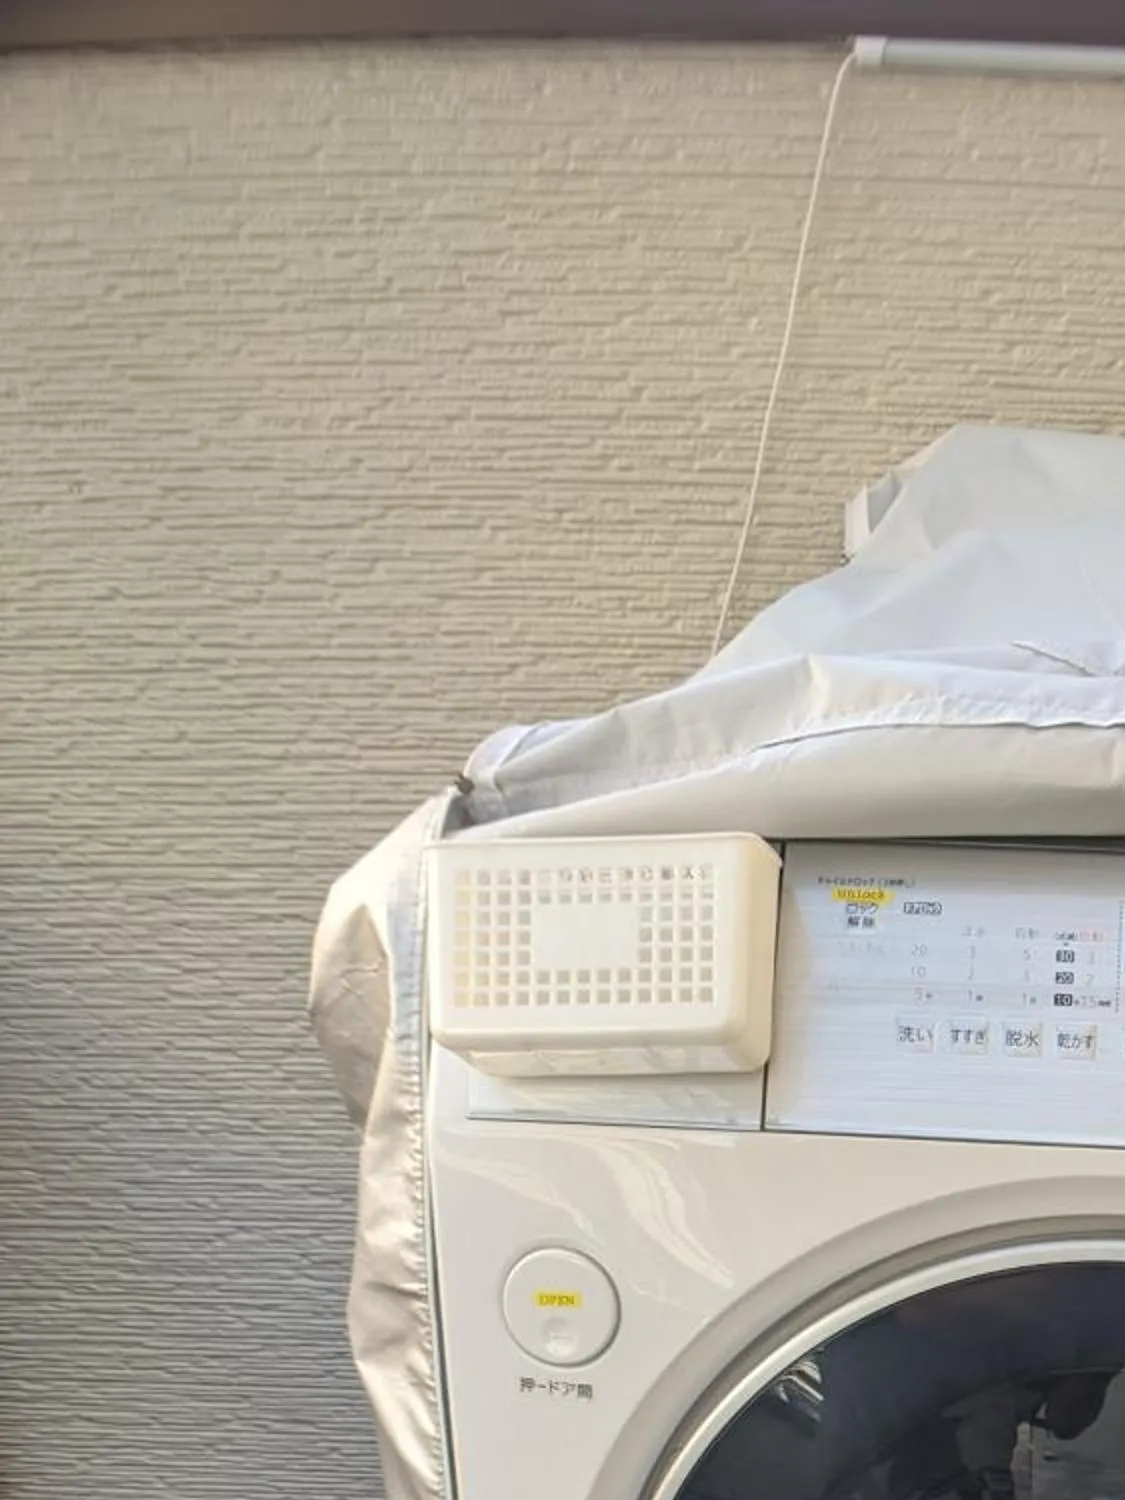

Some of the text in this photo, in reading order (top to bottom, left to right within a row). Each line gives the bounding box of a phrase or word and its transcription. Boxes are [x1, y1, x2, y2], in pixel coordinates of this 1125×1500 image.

[900, 1025, 934, 1044] 洗い
[951, 1027, 985, 1045] すすぎ
[1006, 1029, 1040, 1048] 脱水
